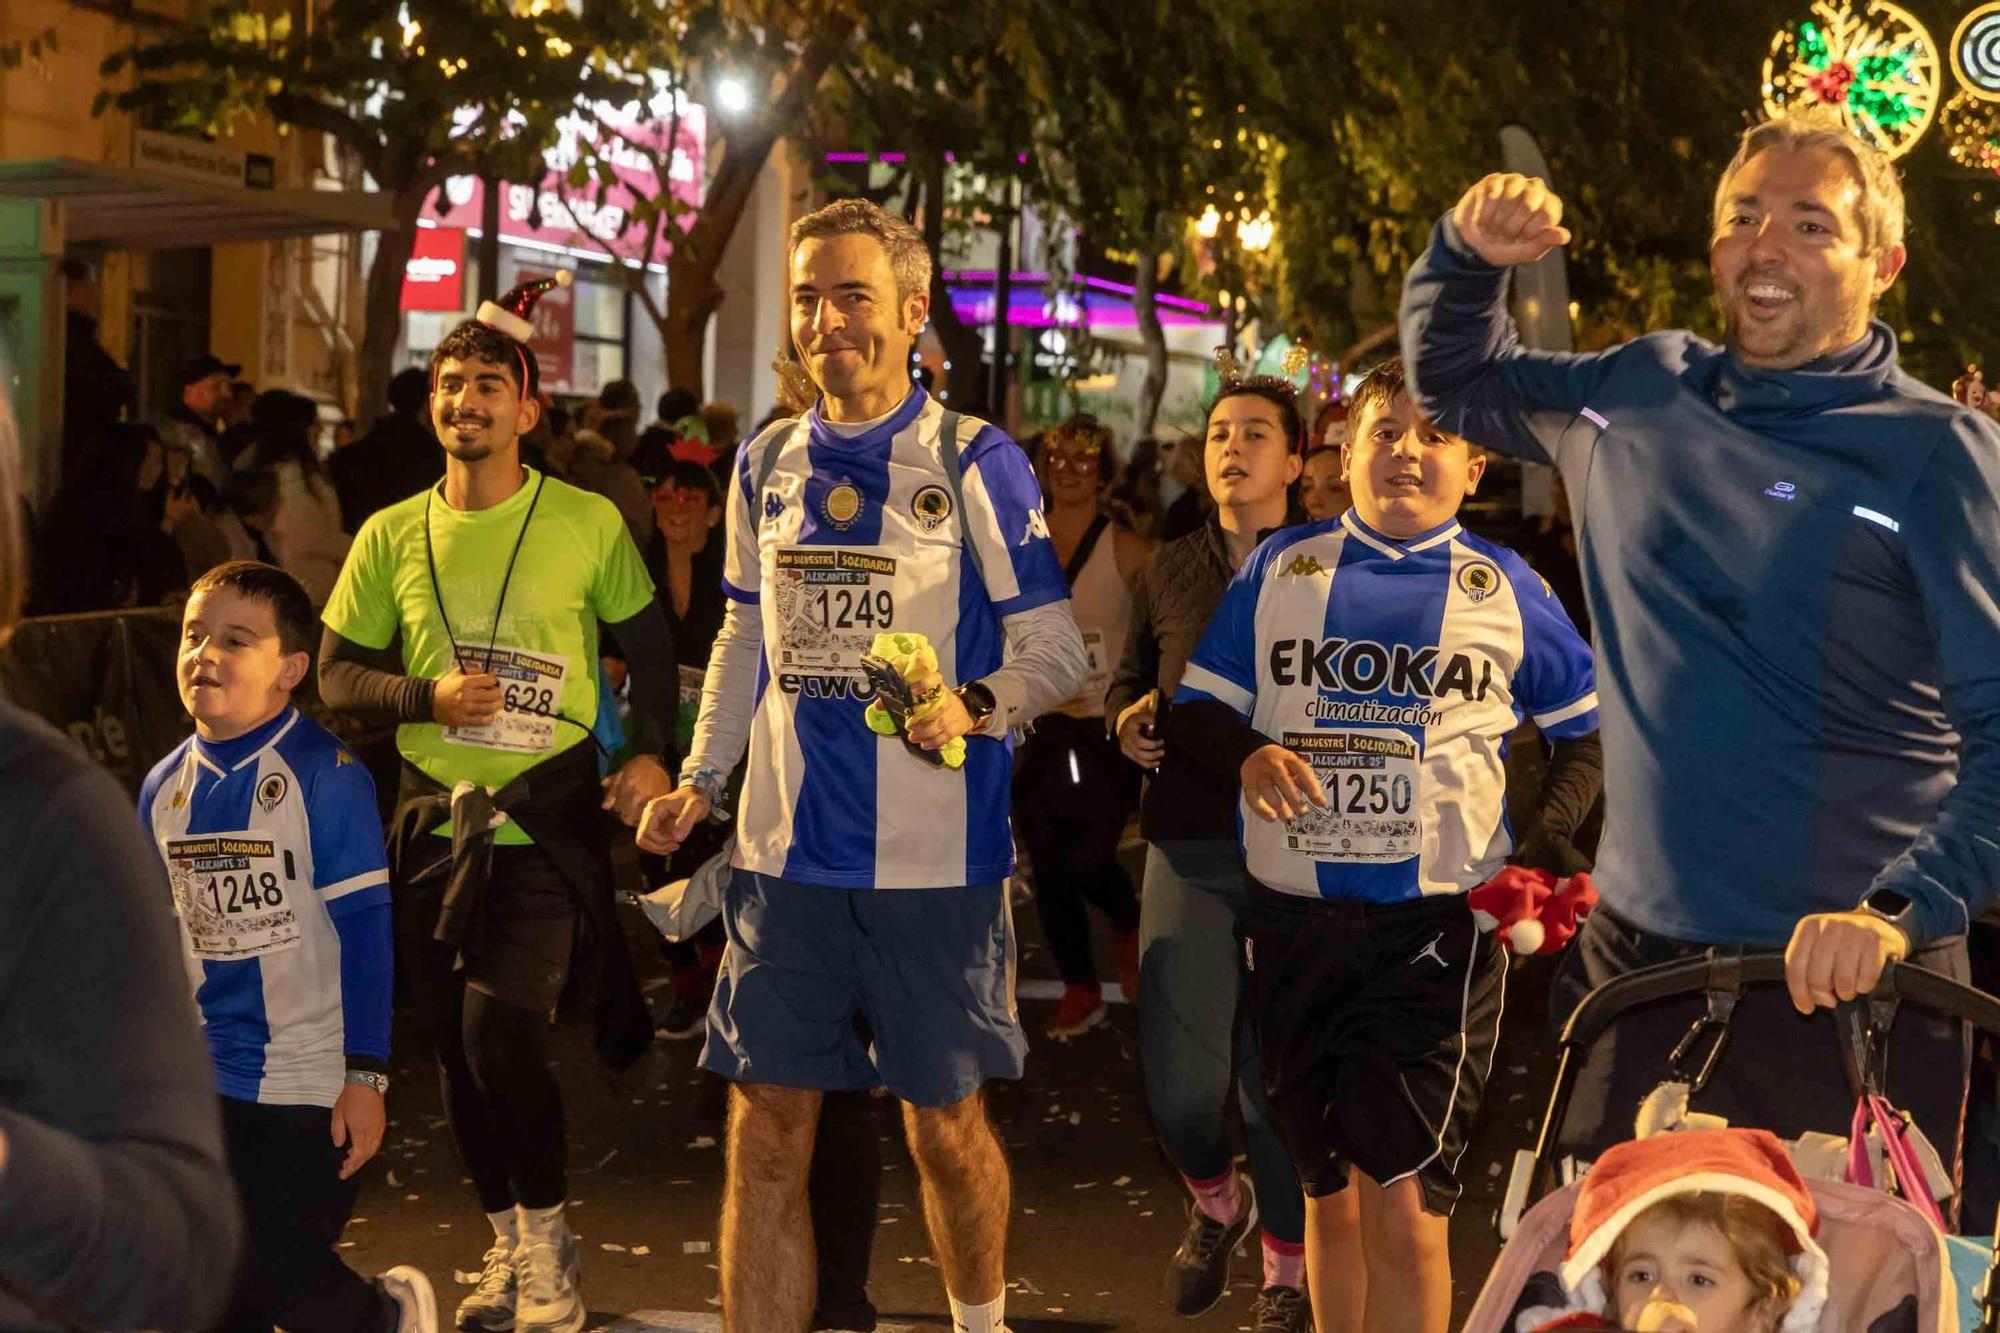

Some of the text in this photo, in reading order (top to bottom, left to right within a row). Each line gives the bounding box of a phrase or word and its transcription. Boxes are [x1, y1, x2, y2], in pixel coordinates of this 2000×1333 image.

[793, 555, 834, 565] SILVESTRE
[842, 555, 894, 573] SOLIDARIA
[806, 571, 853, 583] ALICANTE
[817, 589, 894, 629] 1249
[516, 655, 561, 677] SOLIDARIA
[1270, 639, 1491, 701] EKOKAI
[495, 681, 553, 717] 628
[1305, 695, 1442, 726] climatización
[1285, 736, 1412, 756] SAN SILVESTRE SOLIDARIA
[1314, 755, 1365, 767] ALICANTE
[1326, 773, 1411, 814] 1250
[183, 843, 217, 853] SILVESTRE
[222, 842, 271, 854] SOLIDARIA
[196, 858, 235, 870] ALICANTE
[208, 872, 283, 913] 1248
